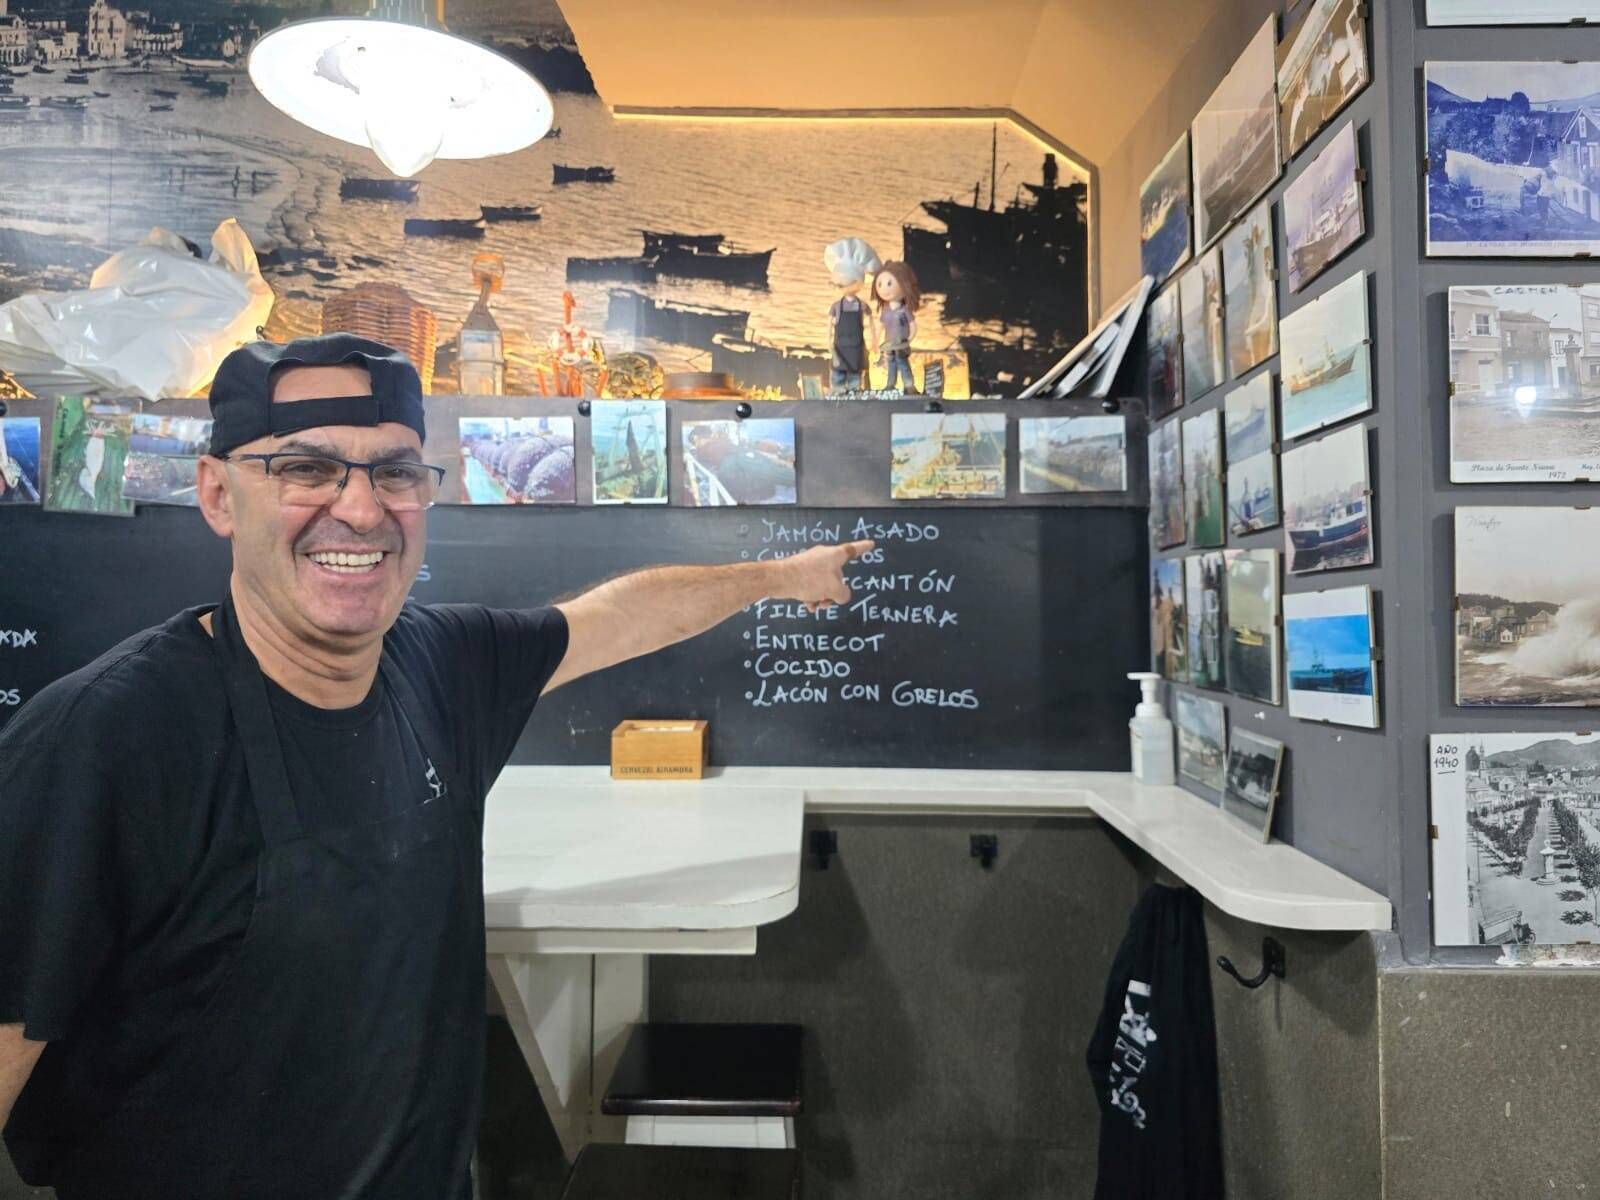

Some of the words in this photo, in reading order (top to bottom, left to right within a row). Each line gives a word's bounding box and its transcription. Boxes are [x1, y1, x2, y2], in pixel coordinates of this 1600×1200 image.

[762, 518, 840, 543] JAMÓN
[851, 517, 939, 543] ASADO
[850, 593, 958, 628] TERNERA
[756, 625, 885, 652] ENTRECOT
[755, 653, 850, 678] COCIDO
[753, 679, 828, 706] LACÓN
[841, 684, 880, 701] CON
[892, 681, 979, 709] GRELOS
[1436, 744, 1458, 755] AÑO
[1434, 757, 1459, 769] 1940
